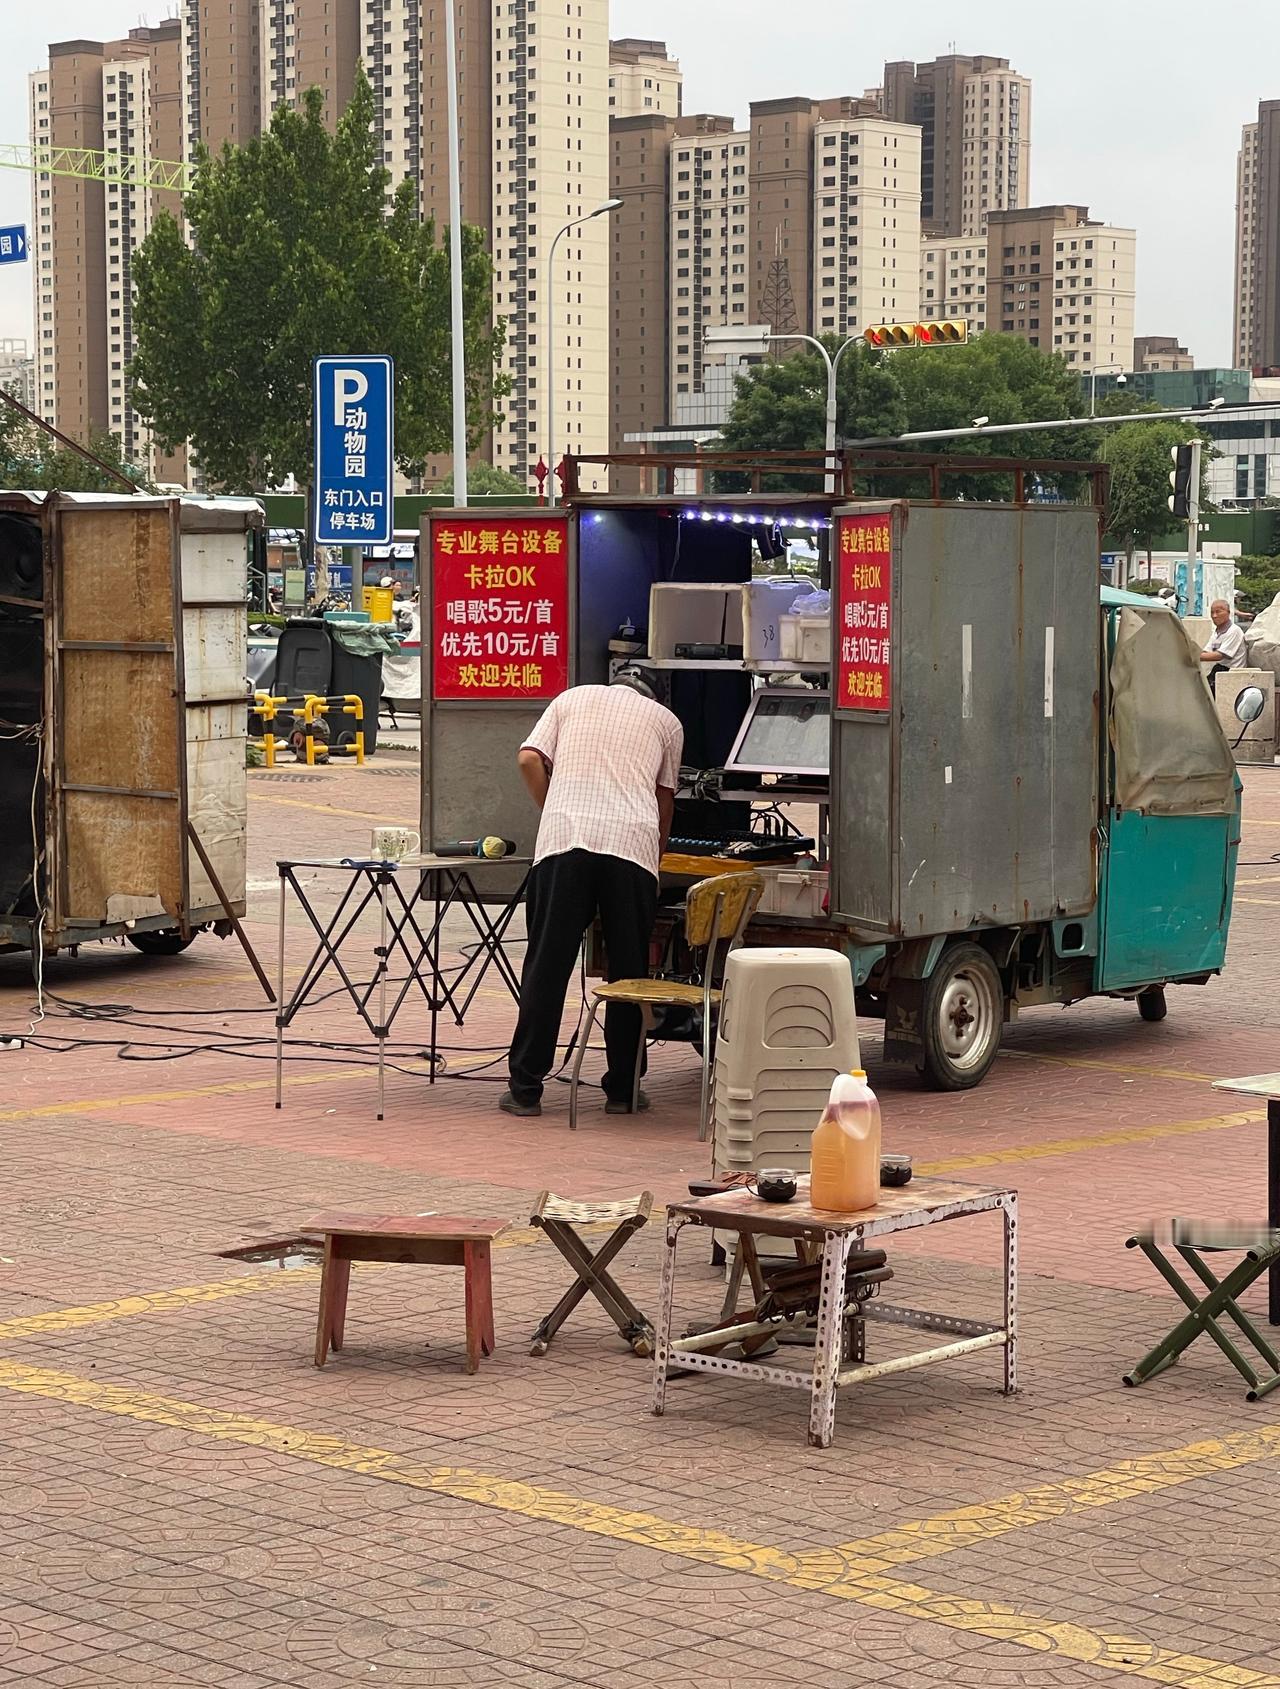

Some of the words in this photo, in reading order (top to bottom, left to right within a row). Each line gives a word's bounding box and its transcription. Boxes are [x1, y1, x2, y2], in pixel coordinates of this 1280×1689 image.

[334, 369, 368, 426] P
[343, 407, 367, 478] 动物园
[324, 489, 383, 507] 东门入口
[330, 512, 375, 531] 停车场
[436, 530, 563, 555] 专业舞台设备
[841, 528, 890, 554] 专业舞台设备
[464, 564, 536, 589] 卡拉OK
[852, 564, 881, 591] 卡拉OK
[446, 598, 554, 625] 唱歌5元/首
[845, 600, 889, 629] 唱歌5元/首
[441, 631, 560, 657] 优先10元/首
[842, 636, 891, 665] 优先10元/首
[459, 664, 542, 688] 欢迎光临
[847, 670, 883, 698] 欢迎光临
